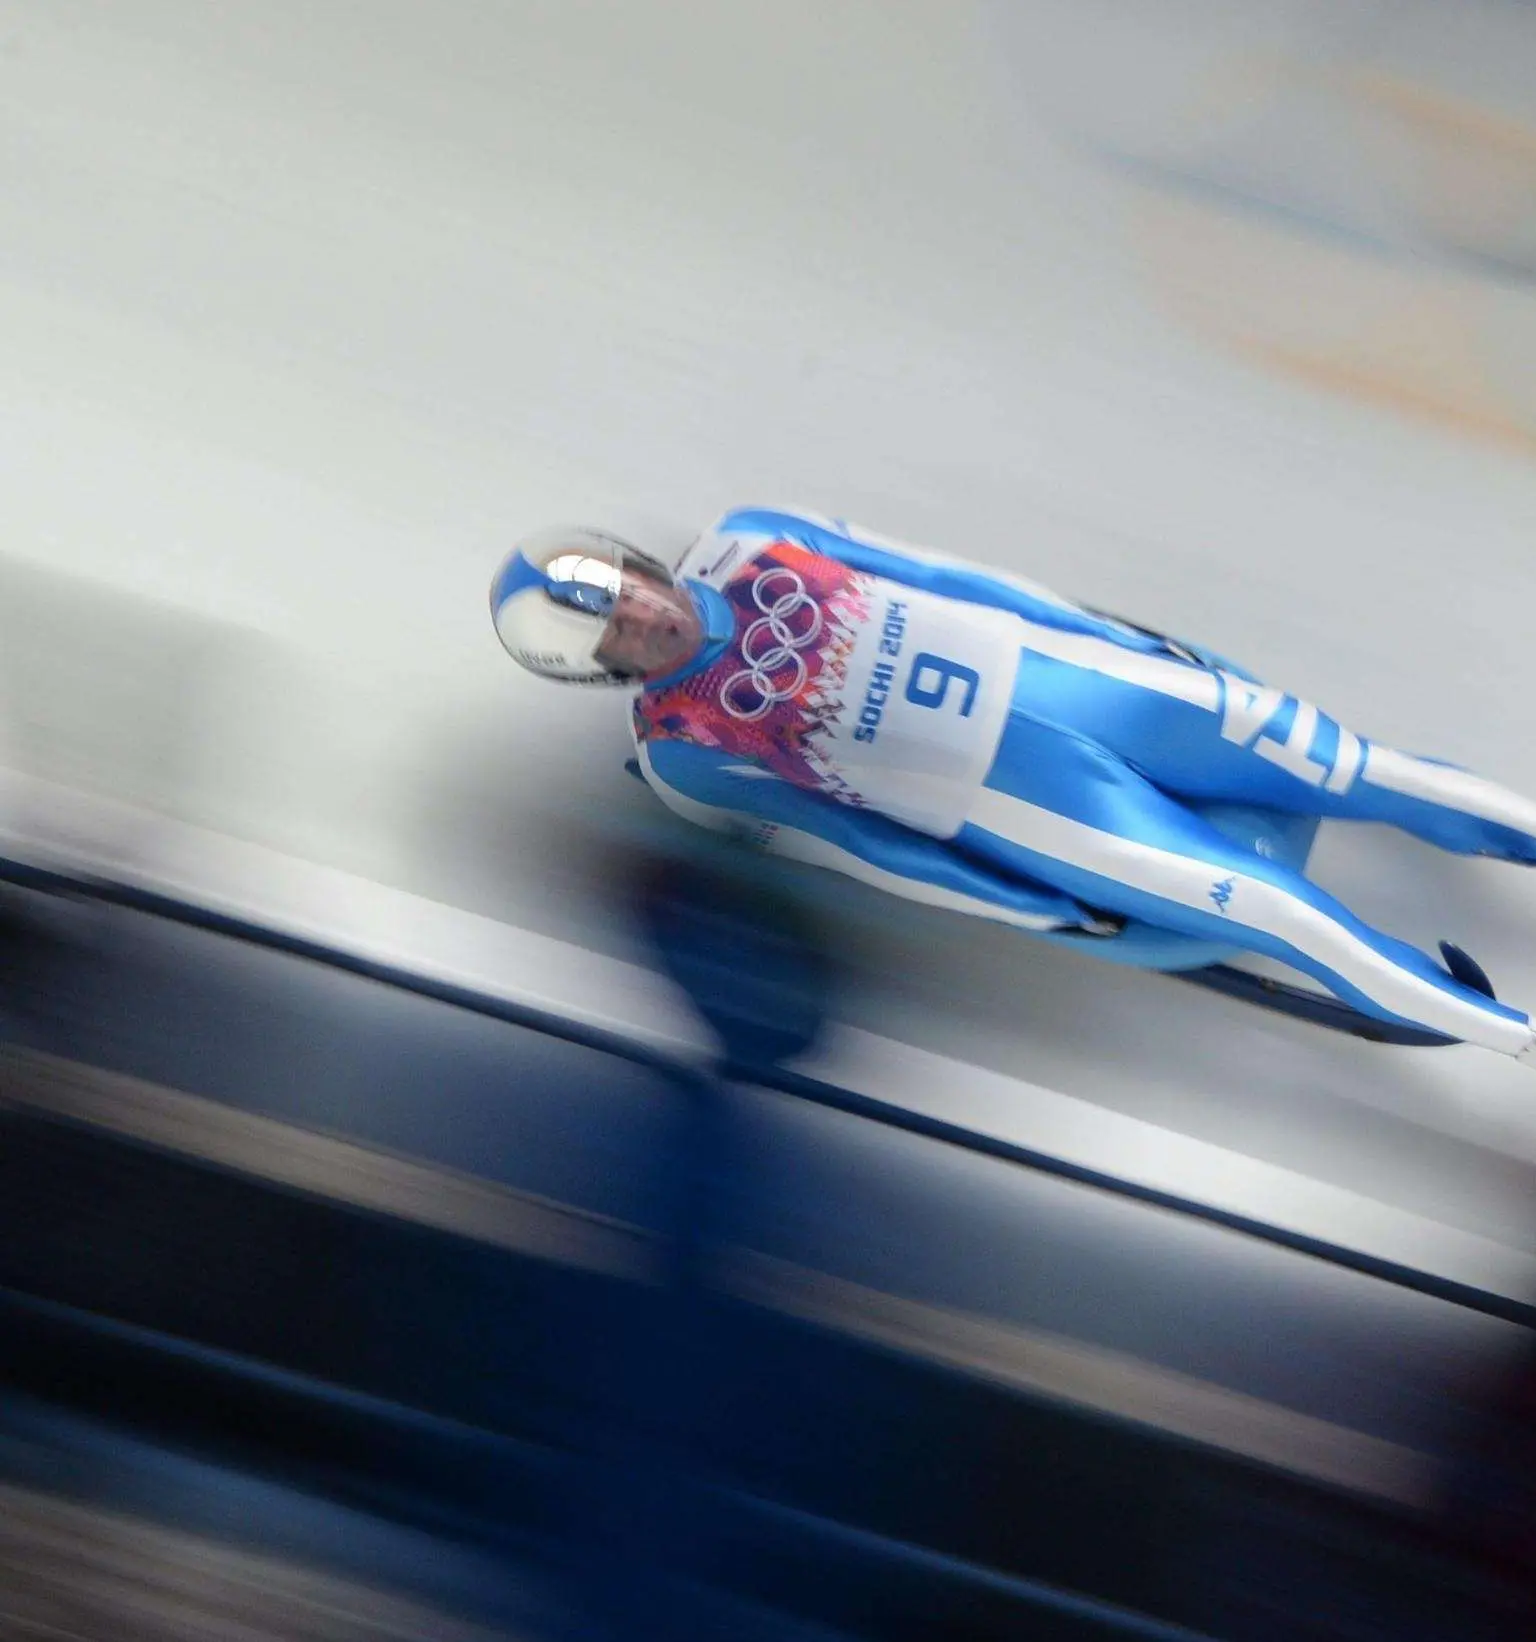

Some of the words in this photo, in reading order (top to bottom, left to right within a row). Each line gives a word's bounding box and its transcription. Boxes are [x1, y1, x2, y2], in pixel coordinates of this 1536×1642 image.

[853, 661, 896, 744] SOCHI
[878, 601, 908, 657] 2014
[905, 652, 980, 718] 9
[1216, 668, 1361, 796] ITA
